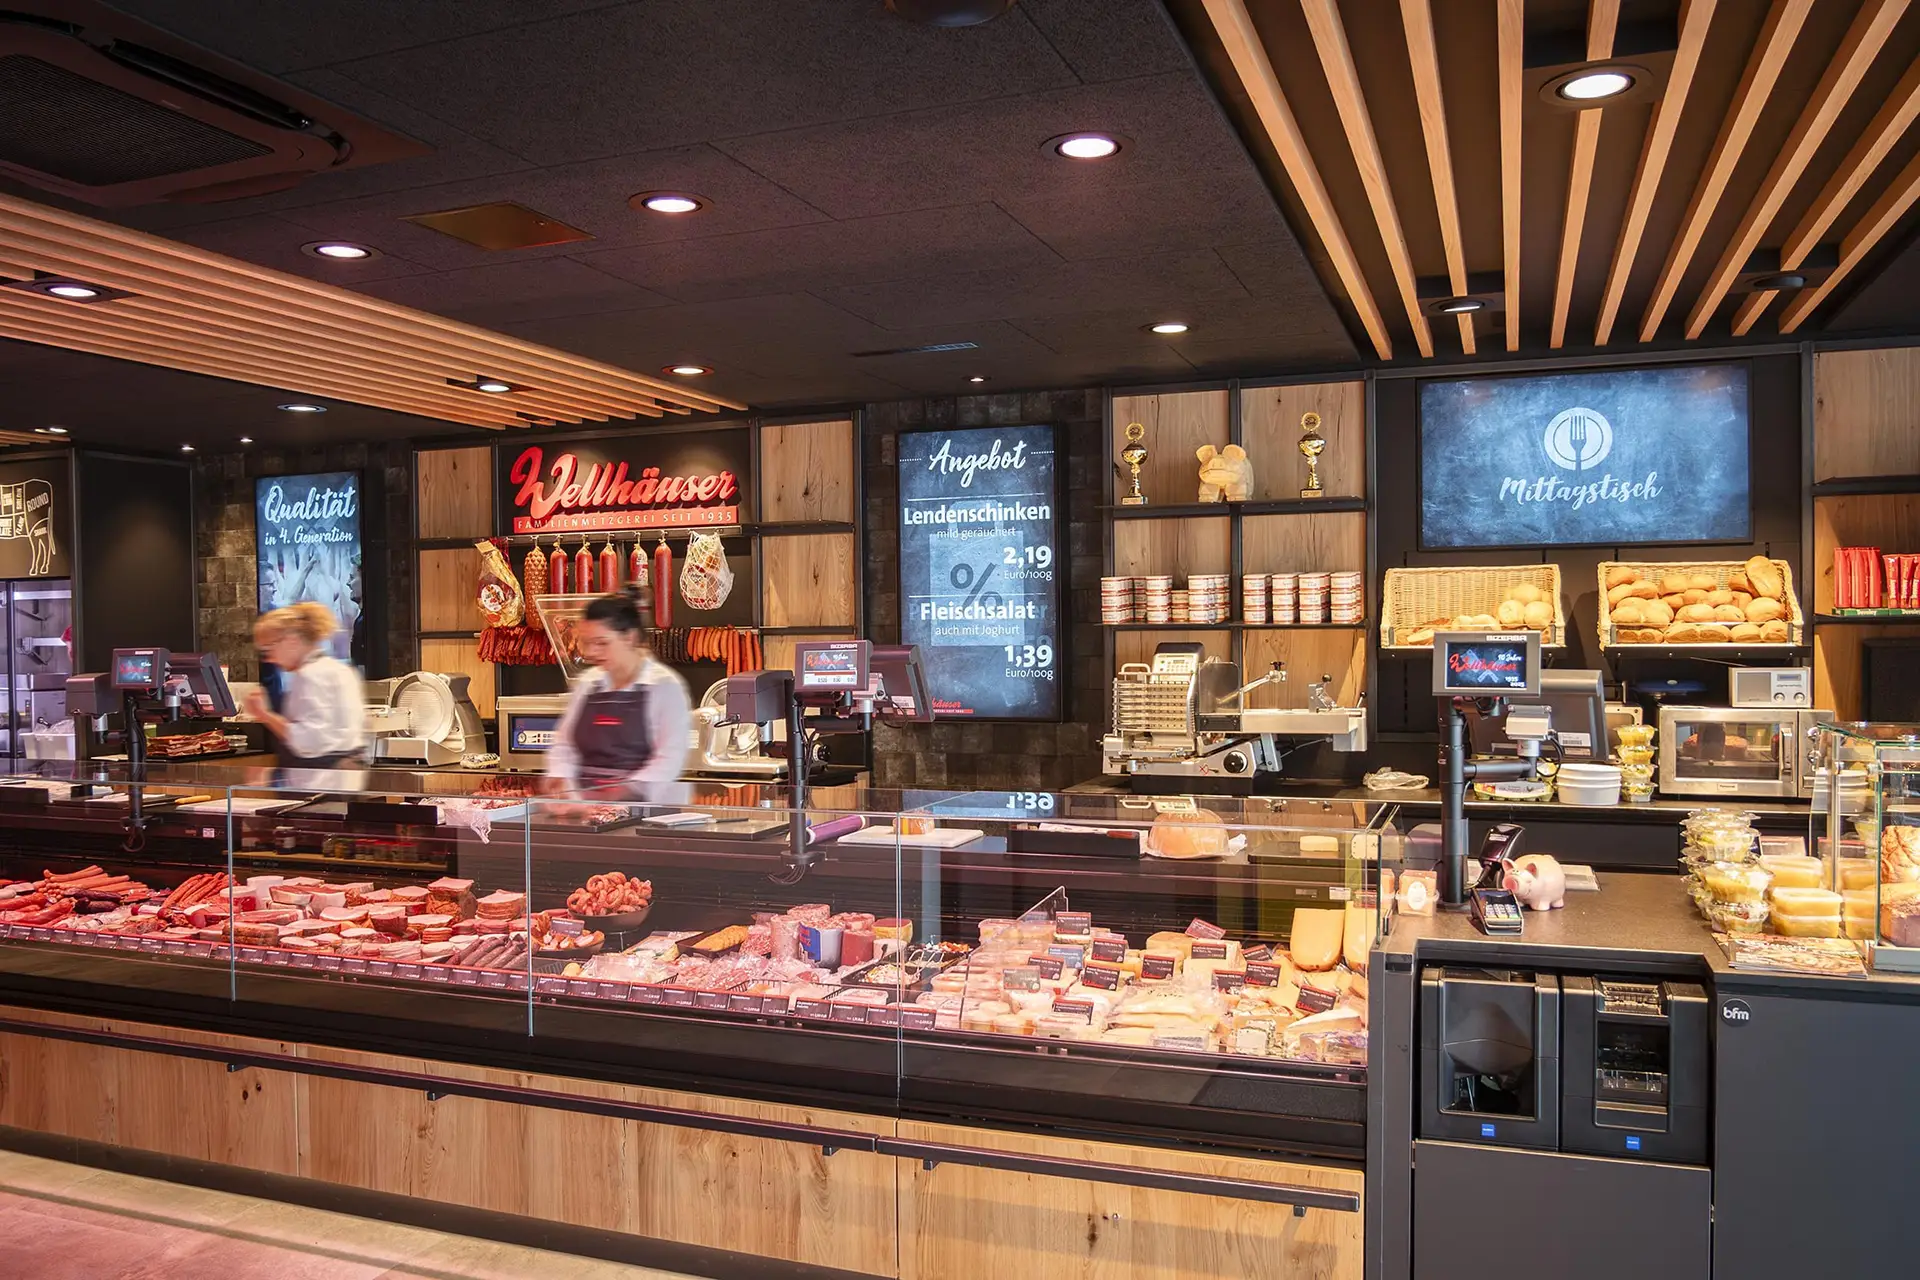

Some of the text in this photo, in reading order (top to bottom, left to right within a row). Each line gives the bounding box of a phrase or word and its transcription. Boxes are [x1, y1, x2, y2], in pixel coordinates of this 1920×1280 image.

[928, 438, 1028, 488] Angebot
[511, 447, 738, 519] Wellhäuser
[1499, 471, 1664, 511] Mittagstisch
[26, 492, 49, 513] ROUND
[264, 485, 357, 524] Qualität
[903, 501, 1051, 525] Lendenschinken
[517, 511, 732, 530] FAMILIENMETZGEREI SEIT 1935
[264, 525, 354, 546] in 4. Generation
[936, 526, 1016, 541] mild geräuchert
[1003, 545, 1052, 569] 2,19
[1003, 569, 1053, 582] Euro/100g
[920, 600, 1036, 621] Fleischsalat
[935, 624, 1020, 638] auch mit Joghurt
[1004, 644, 1053, 668] 1,39
[1005, 667, 1054, 681] Euro/100g
[931, 697, 961, 708] häuser
[1723, 1006, 1749, 1021] bfm
